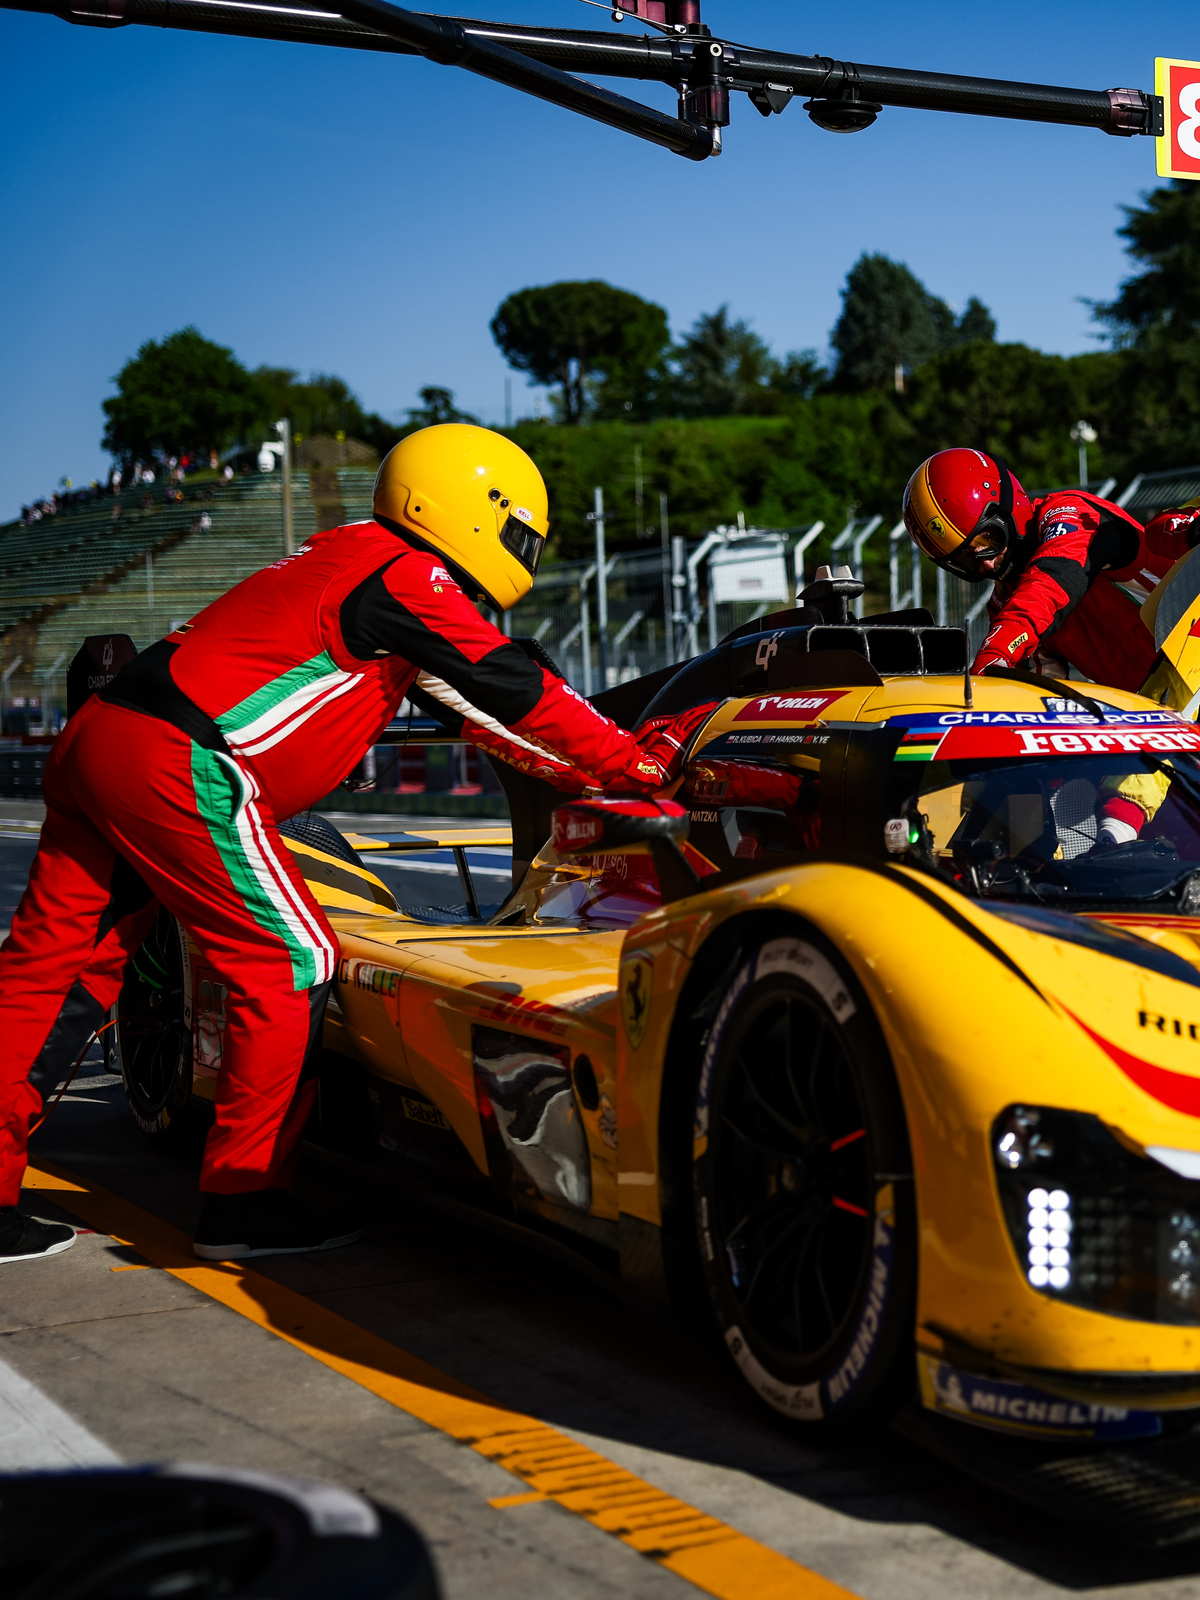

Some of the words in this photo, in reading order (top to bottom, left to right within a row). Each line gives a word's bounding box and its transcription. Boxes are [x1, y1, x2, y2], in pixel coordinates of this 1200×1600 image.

[516, 508, 531, 521] BELL
[777, 697, 829, 709] ORLEN
[938, 712, 1100, 725] CHARLES
[1103, 712, 1177, 725] POZZI
[733, 735, 763, 744] R.KUBICA
[769, 735, 804, 744] P.HANSON
[811, 735, 830, 745] Y.YE
[476, 742, 530, 772] ORLEN
[691, 810, 718, 823] NATZKA
[567, 823, 596, 840] ORLEN
[181, 939, 189, 970] SPORT
[354, 962, 399, 998] MILLE
[405, 1099, 446, 1128] Sabelt
[828, 1255, 890, 1403] MICHELIN
[972, 1389, 1129, 1424] MICHELIN
